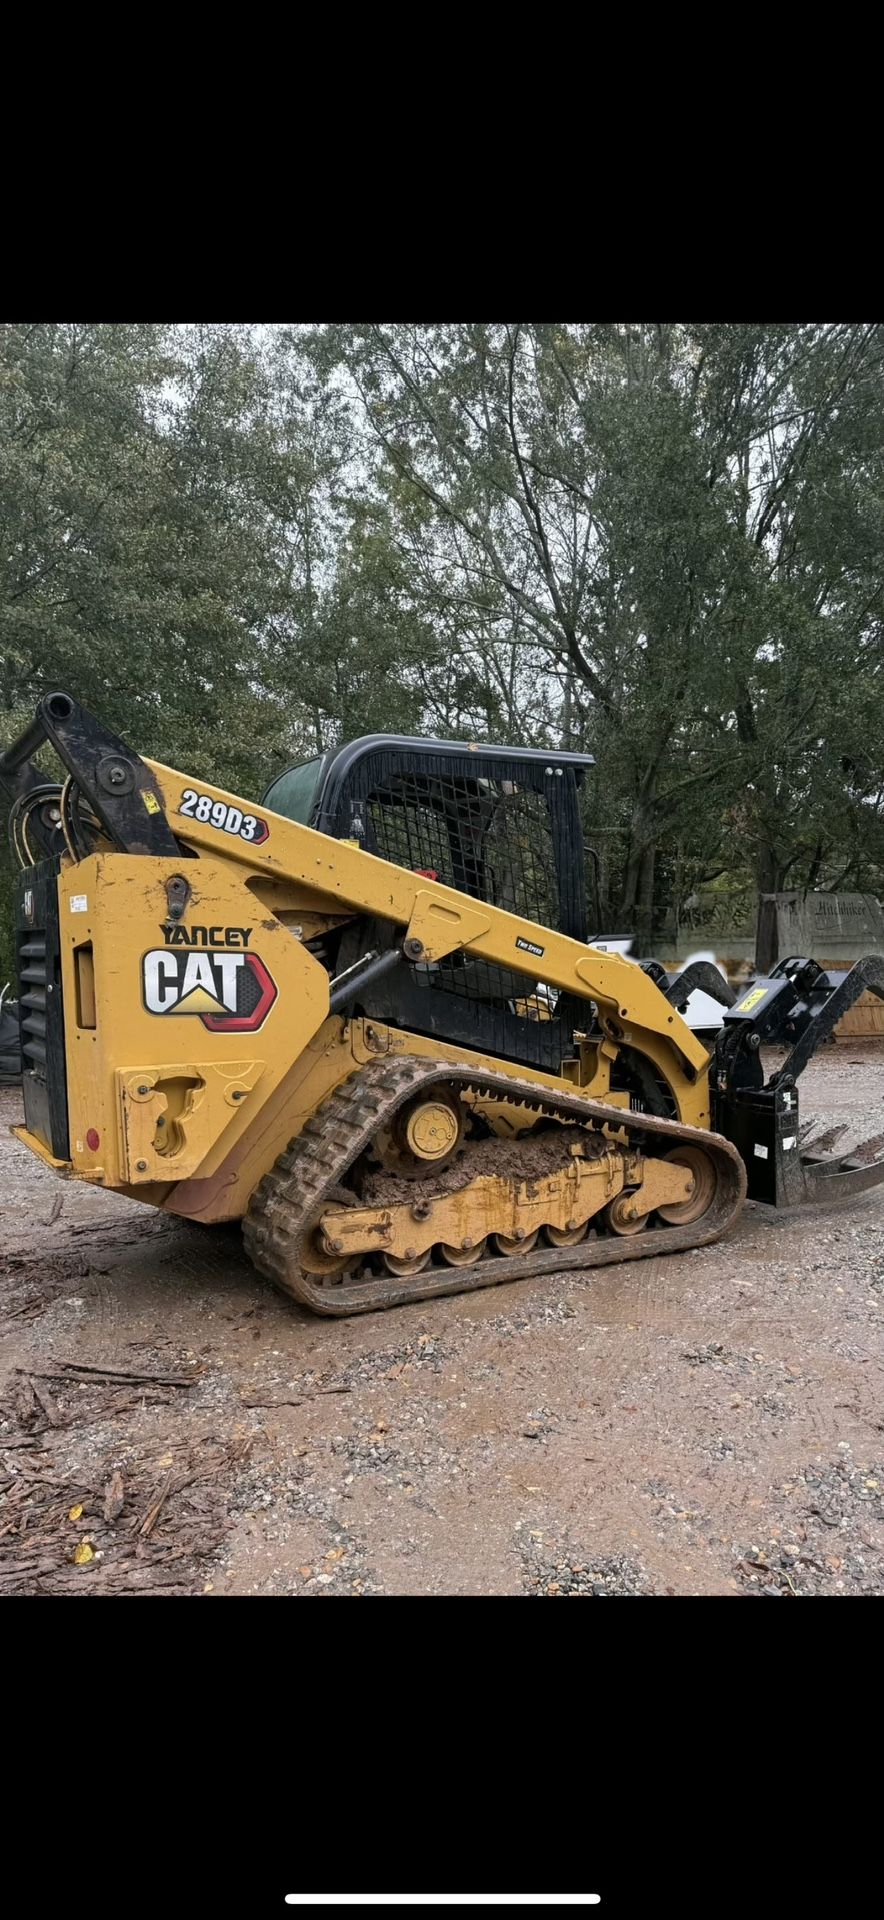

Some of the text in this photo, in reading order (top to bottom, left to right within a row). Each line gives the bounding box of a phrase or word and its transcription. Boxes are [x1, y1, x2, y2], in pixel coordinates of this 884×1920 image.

[180, 790, 257, 840] 289D3
[159, 924, 253, 947] YANCEY
[144, 950, 245, 1012] CAT
